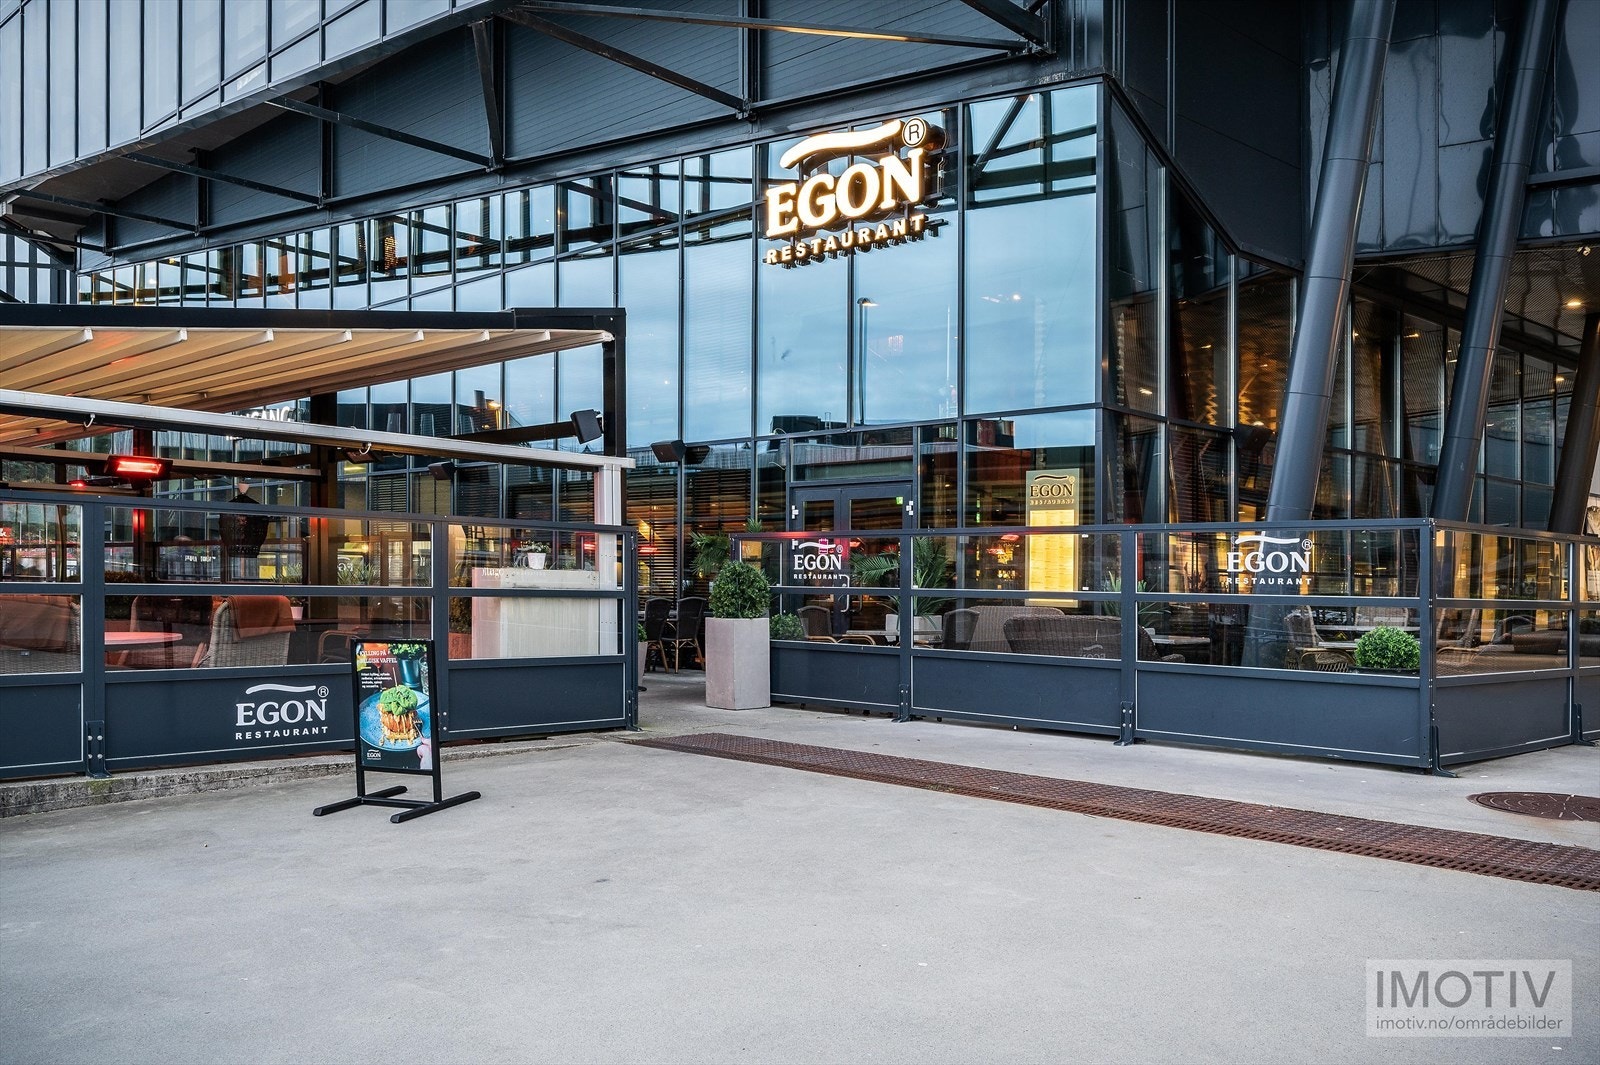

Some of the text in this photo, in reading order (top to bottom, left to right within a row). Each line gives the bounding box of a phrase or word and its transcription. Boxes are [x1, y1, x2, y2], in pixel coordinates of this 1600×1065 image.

[765, 148, 924, 238] EGON
[766, 213, 925, 265] RESTAURANT
[1030, 483, 1074, 497] EGON
[793, 554, 843, 570] EGON
[1226, 551, 1311, 573] EGON
[1226, 577, 1312, 585] RESTAURANT
[235, 698, 327, 726] EGON
[235, 726, 328, 740] RESTAURANT
